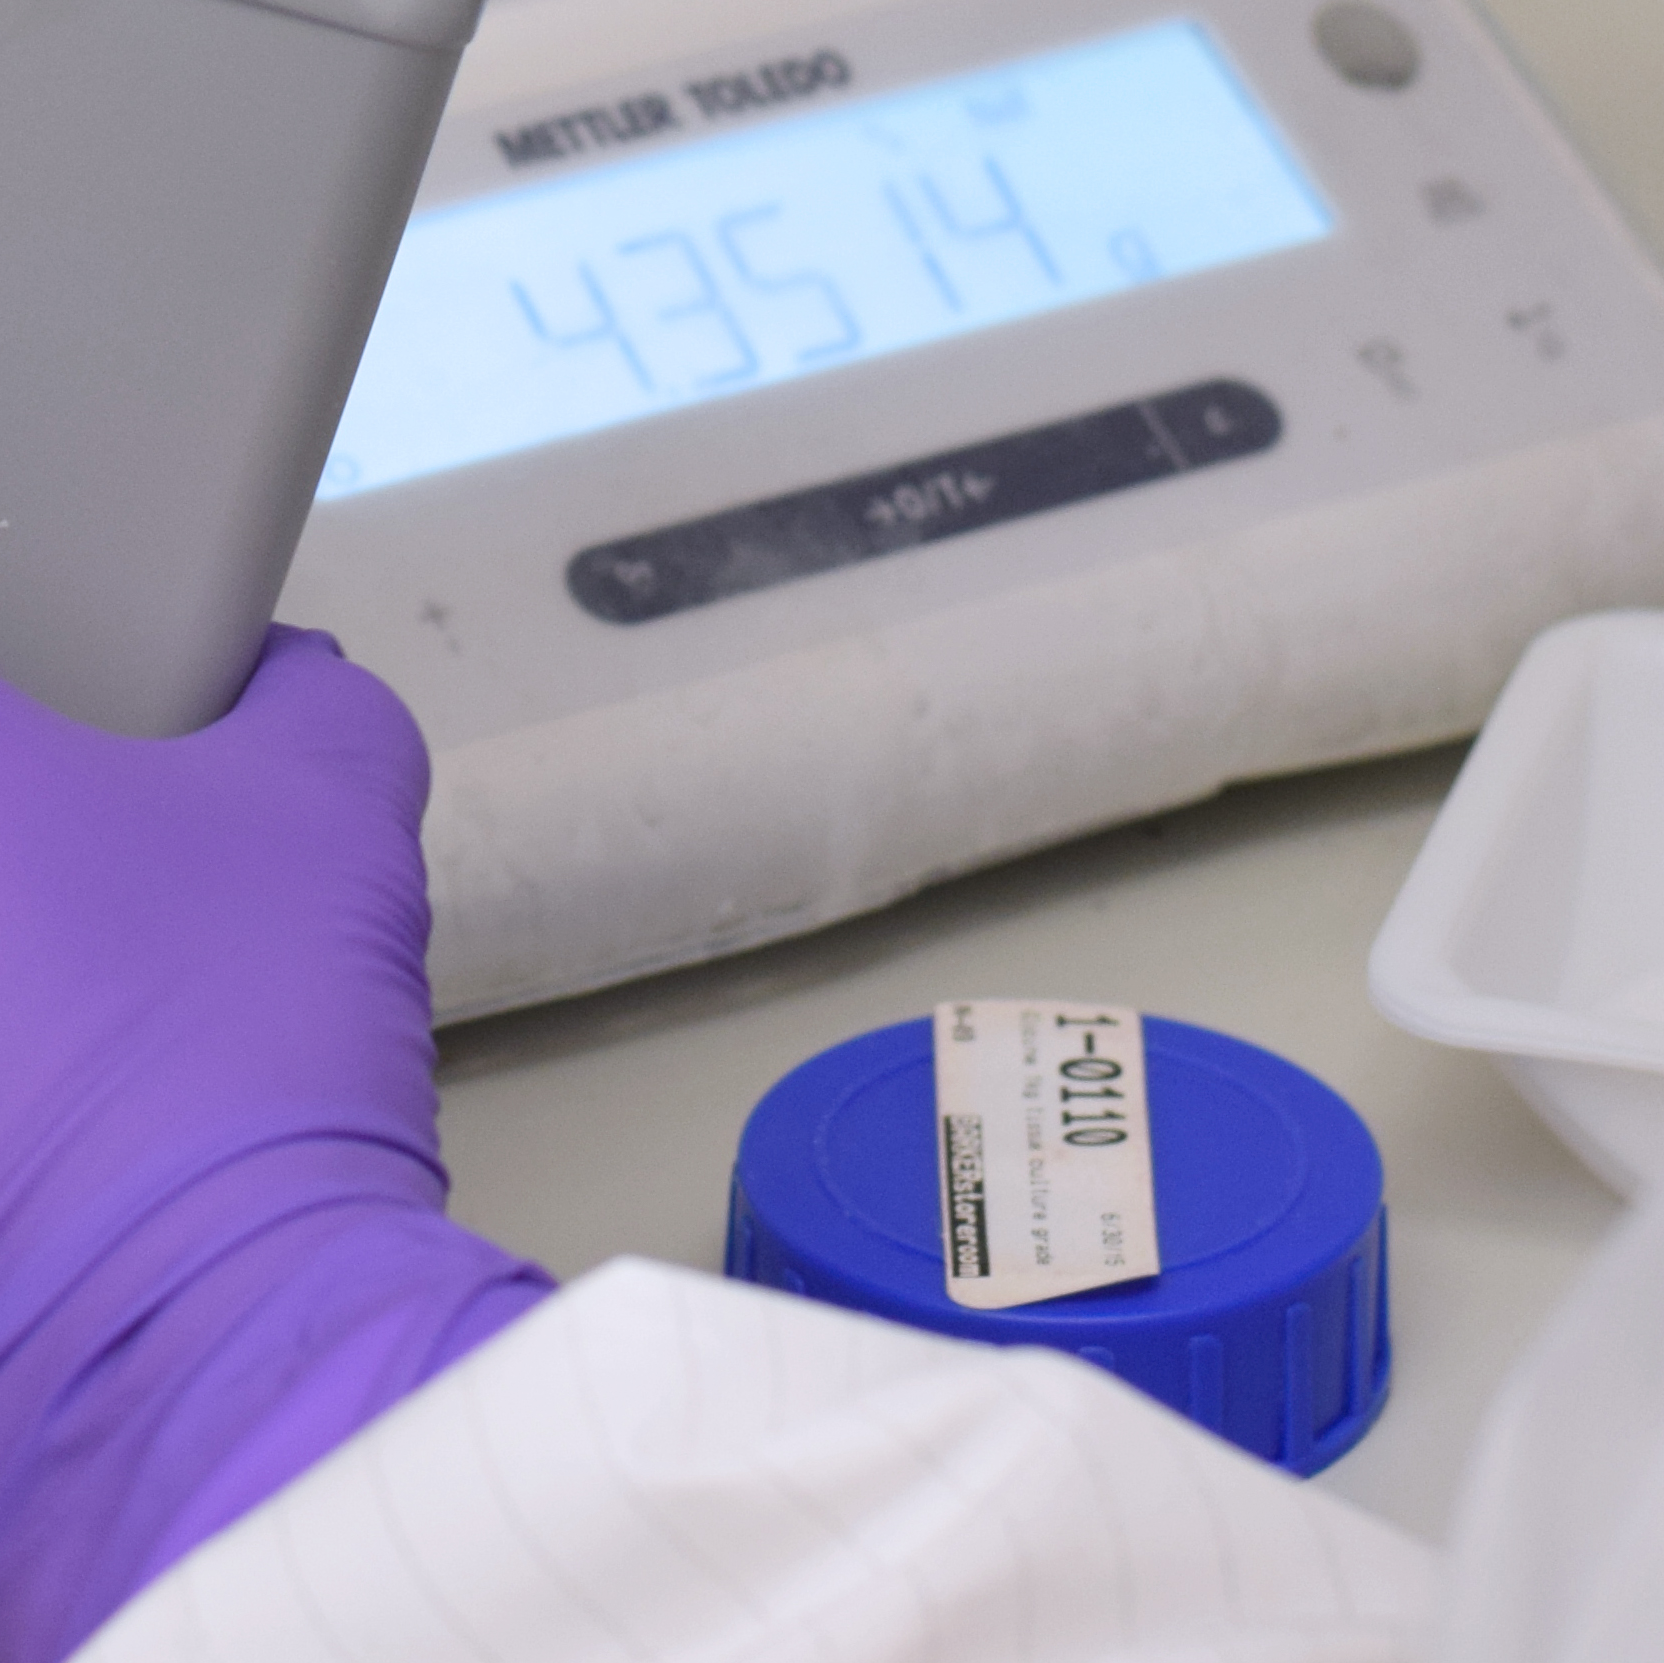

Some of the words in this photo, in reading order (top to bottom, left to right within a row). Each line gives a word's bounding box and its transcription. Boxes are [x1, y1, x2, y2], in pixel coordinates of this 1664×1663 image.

[495, 91, 679, 170] METTLER
[683, 48, 853, 118] TOLEDO
[1055, 1013, 1128, 1147] 1-0110
[1027, 1156, 1051, 1220] culture
[1030, 1226, 1052, 1266] grade
